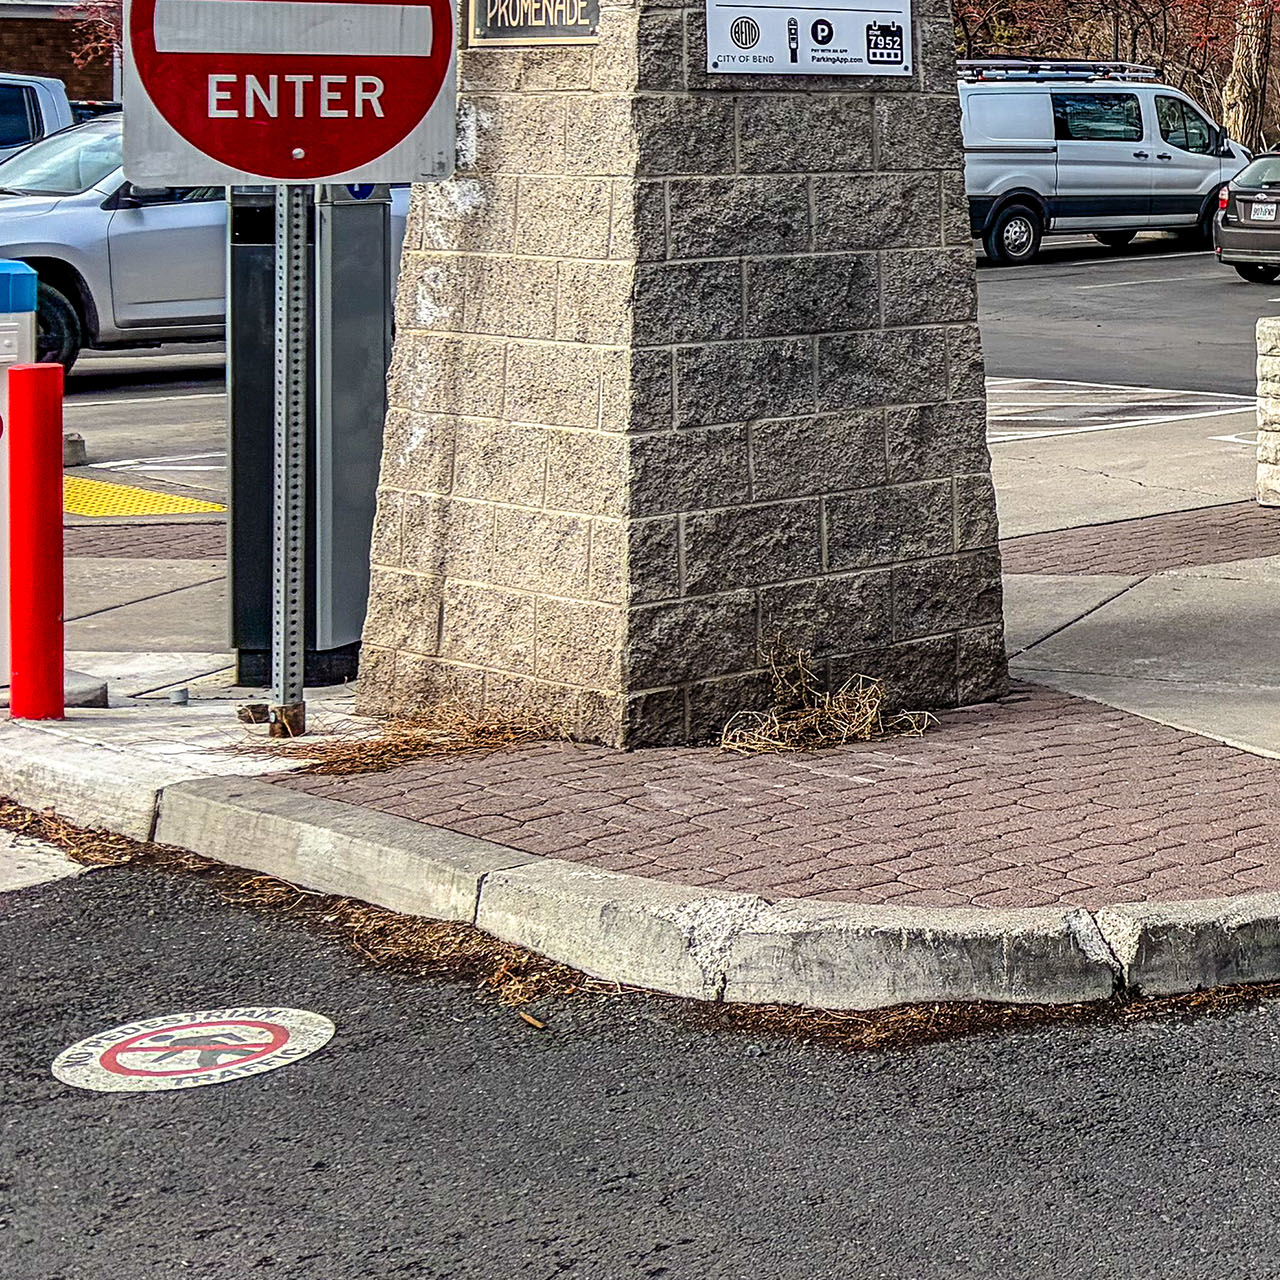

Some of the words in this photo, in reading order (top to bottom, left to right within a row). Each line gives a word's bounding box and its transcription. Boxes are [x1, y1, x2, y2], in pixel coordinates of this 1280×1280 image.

[733, 20, 758, 46] BEND
[817, 24, 829, 41] P
[869, 36, 901, 49] 7952
[716, 54, 736, 63] CITY
[738, 55, 750, 63] OF
[752, 55, 775, 64] BEND
[811, 56, 863, 64] ParkingApp.com
[207, 74, 385, 119] ENTER
[170, 1047, 307, 1086] TRAFFIC
